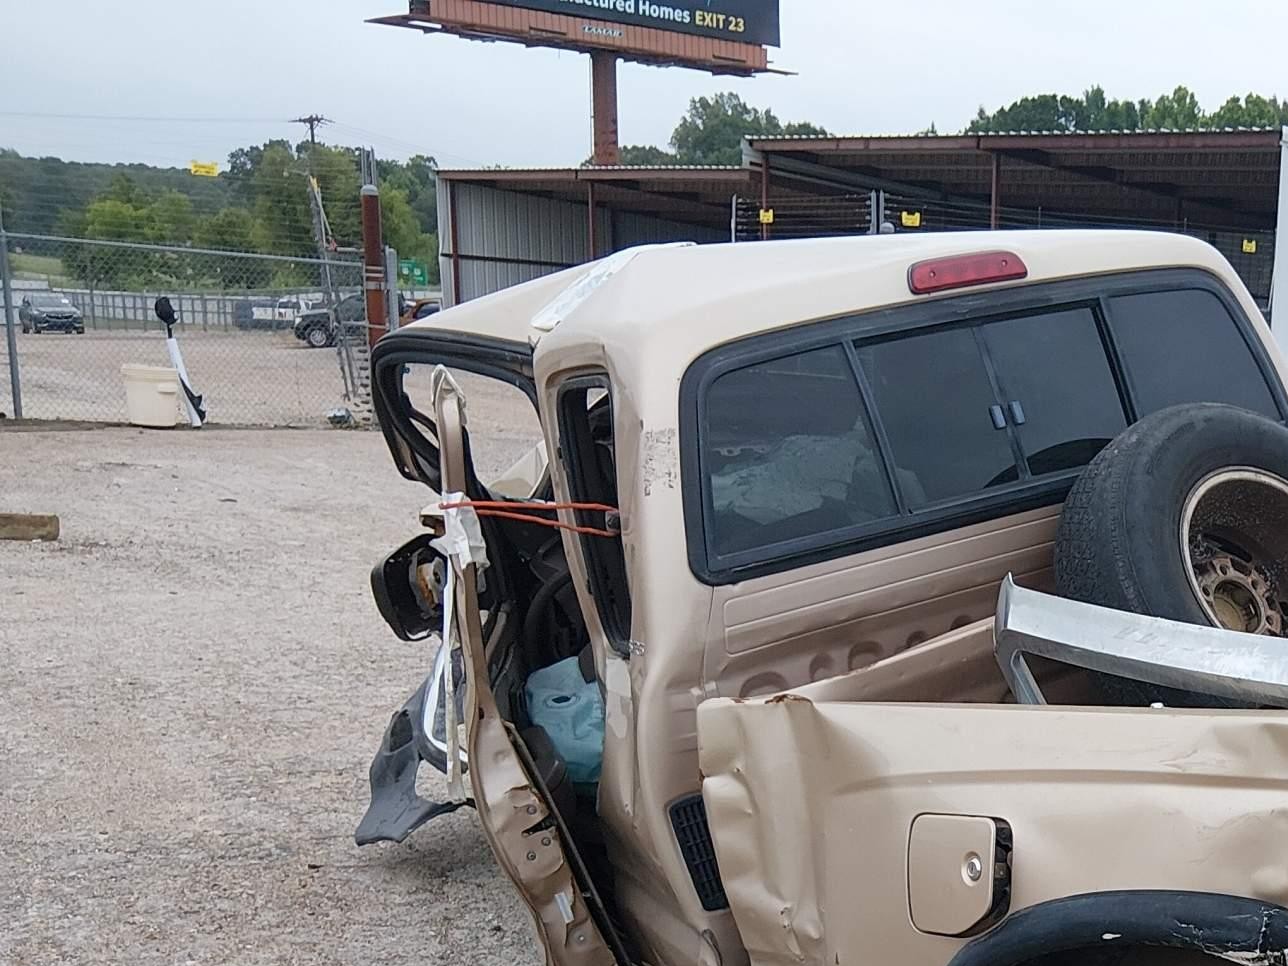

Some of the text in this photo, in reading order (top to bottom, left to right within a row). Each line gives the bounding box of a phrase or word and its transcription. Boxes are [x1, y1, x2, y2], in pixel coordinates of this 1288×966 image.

[639, 1, 691, 24] Homes
[695, 10, 726, 29] EXIT
[728, 17, 745, 33] 23
